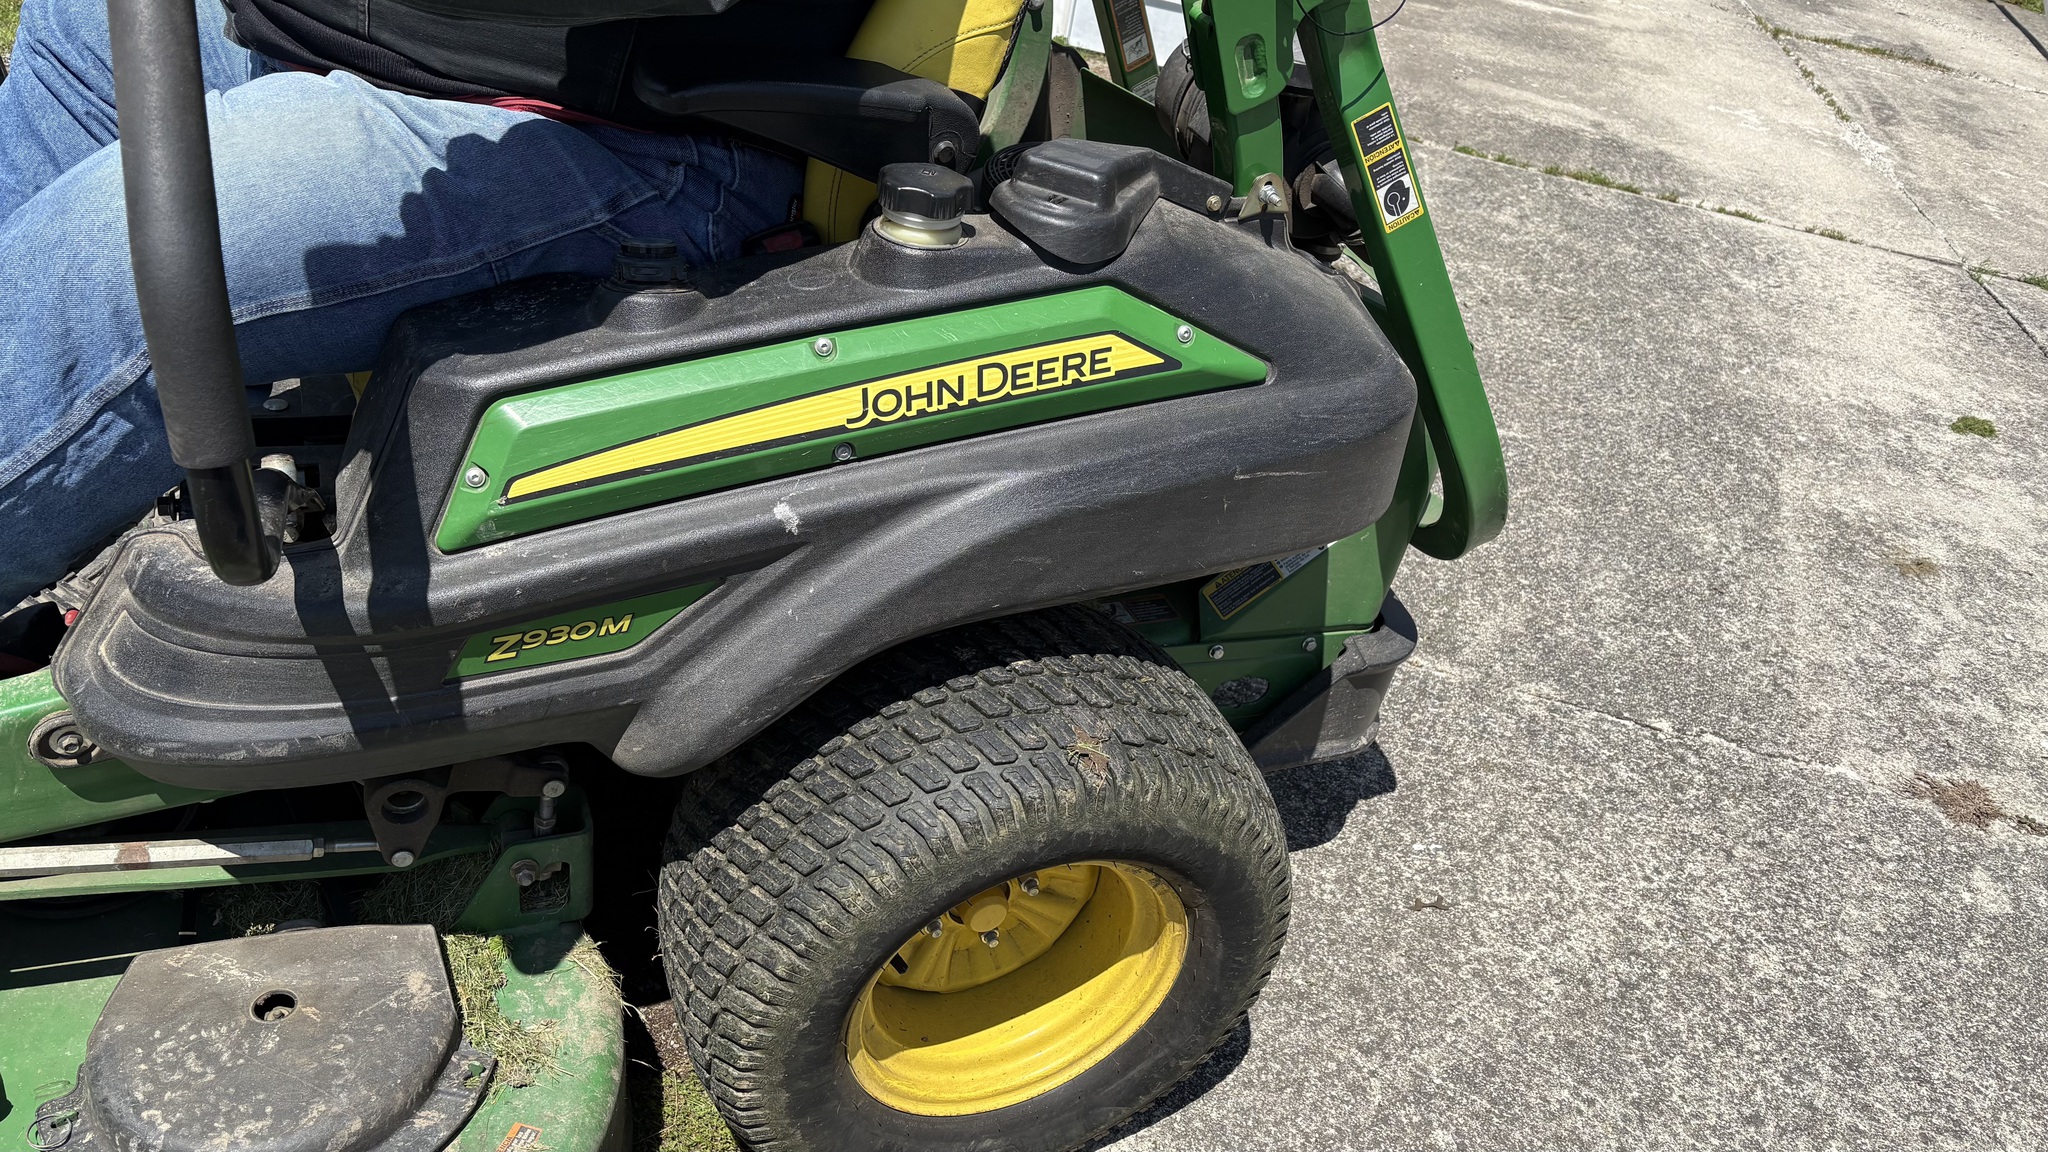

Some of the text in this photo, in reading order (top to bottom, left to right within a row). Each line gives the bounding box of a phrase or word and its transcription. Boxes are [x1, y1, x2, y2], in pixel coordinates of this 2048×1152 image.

[1388, 213, 1416, 231] CAUTION
[846, 346, 1112, 424] JOHN DEERE
[485, 613, 634, 663] Z930M
